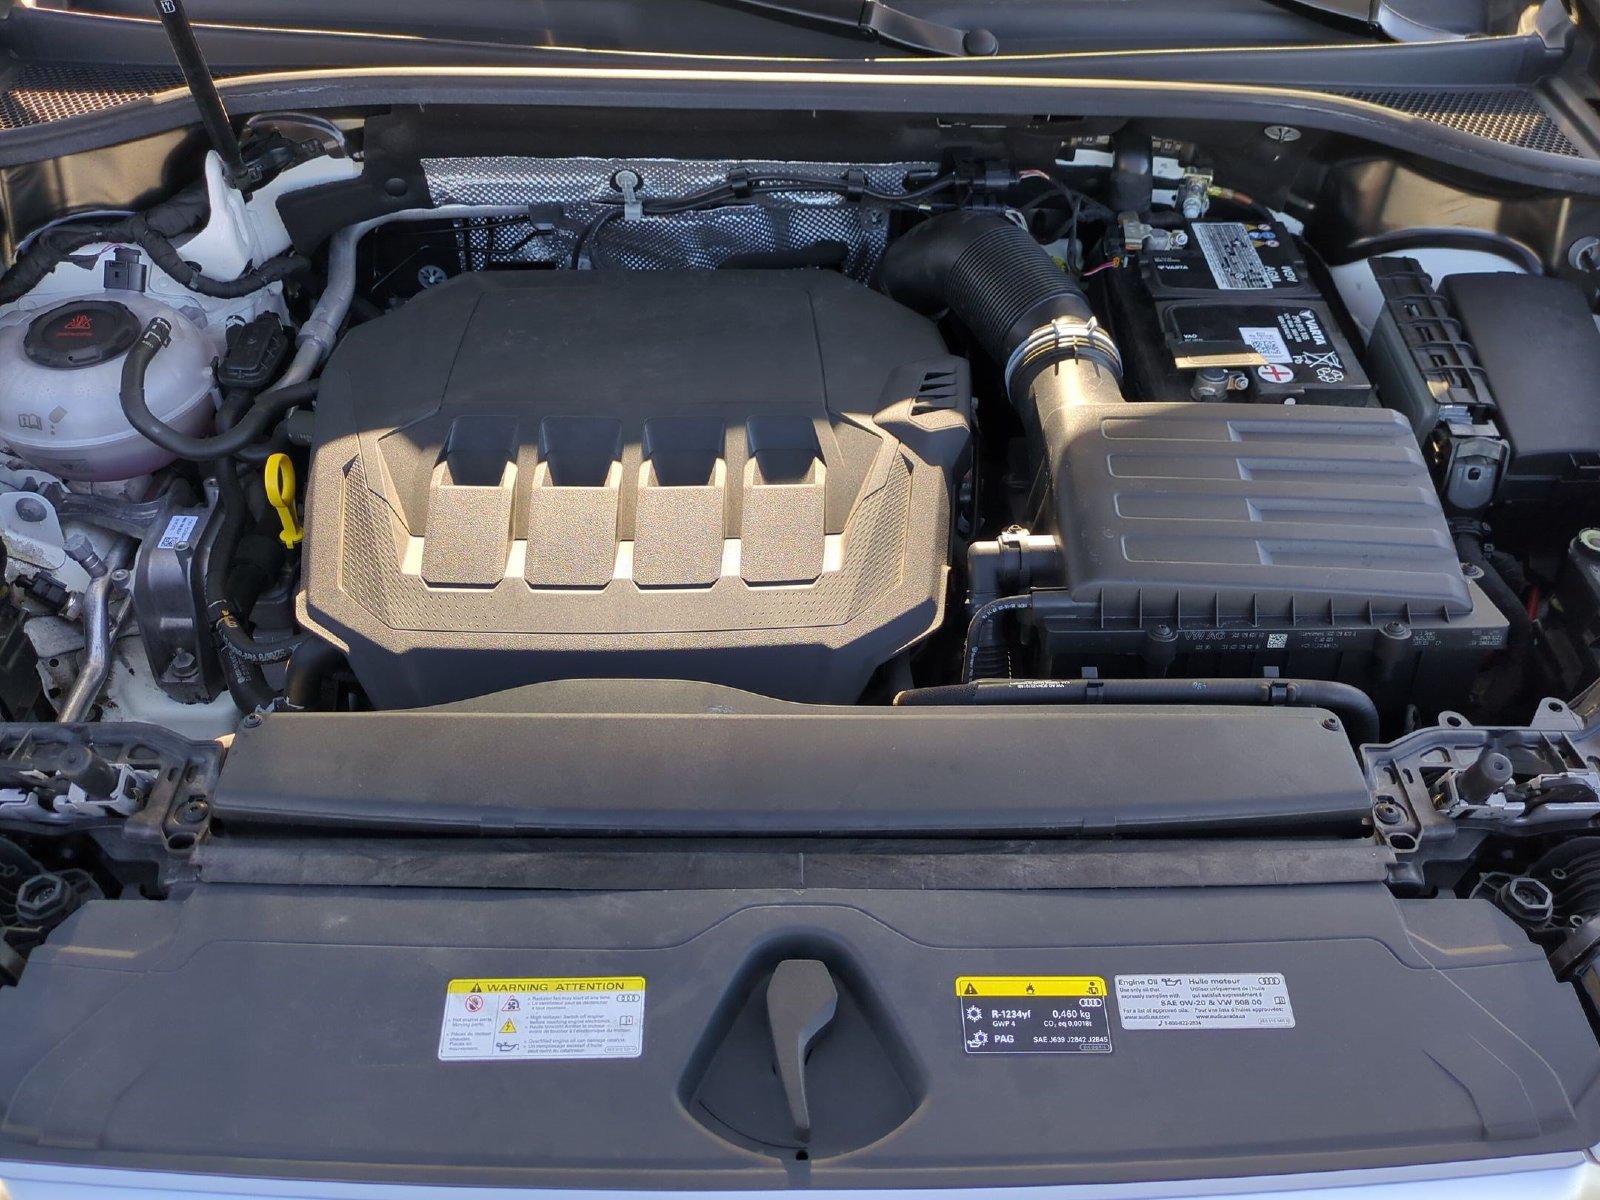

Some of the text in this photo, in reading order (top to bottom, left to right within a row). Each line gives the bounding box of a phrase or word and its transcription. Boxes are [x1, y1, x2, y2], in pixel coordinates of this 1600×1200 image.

[1264, 265, 1282, 282] AGM
[1281, 265, 1299, 282] AGM
[1304, 319, 1327, 346] VARTA
[487, 982, 625, 992] WARNING ATTENTION
[991, 1009, 1091, 1020] R-1234yf 0,460 kg
[994, 1034, 1015, 1043] PAG
